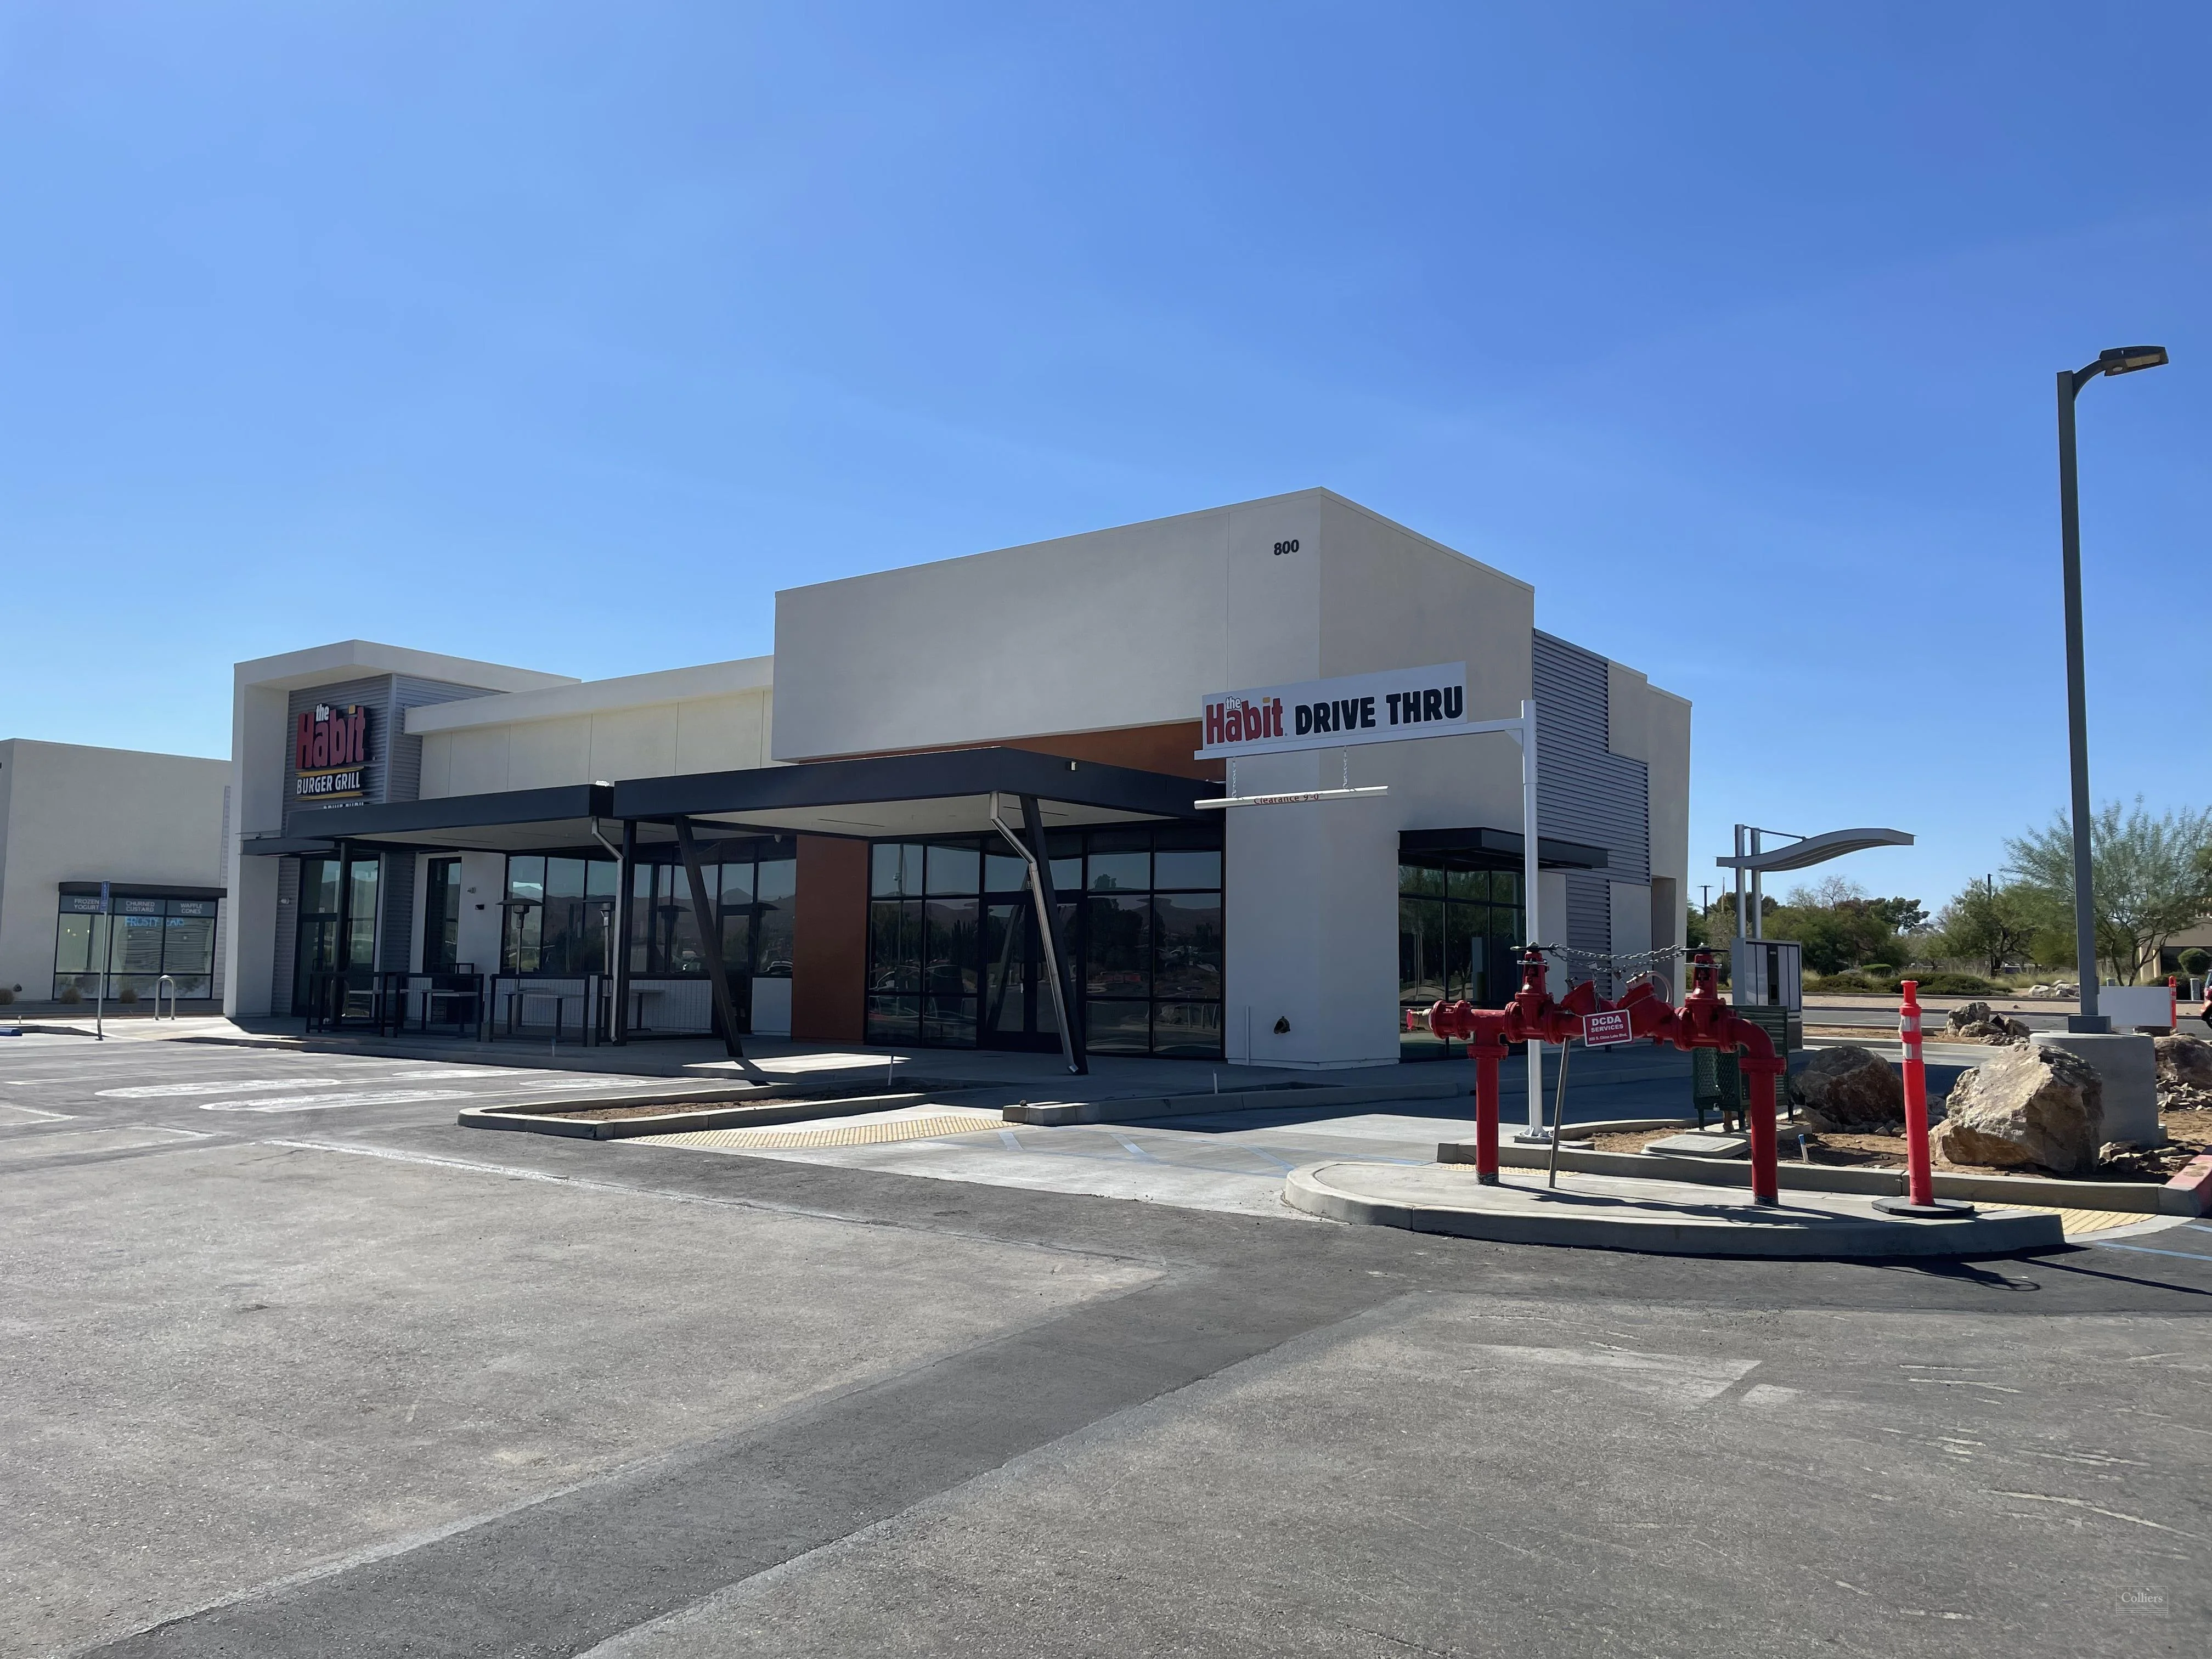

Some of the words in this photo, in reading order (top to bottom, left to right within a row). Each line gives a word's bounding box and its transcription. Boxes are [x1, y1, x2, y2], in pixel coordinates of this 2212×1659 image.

[1274, 539, 1299, 555] 800
[1226, 696, 1241, 710] the
[316, 704, 329, 721] the
[1206, 697, 1283, 744] Habit
[1295, 697, 1375, 735] DRIVE
[1386, 686, 1463, 725] THRU
[296, 705, 366, 769] Habit
[297, 775, 333, 794] BURGER
[335, 772, 360, 790] GRILL
[1254, 795, 1300, 804] Clearance
[125, 916, 159, 927] FROSTY
[1591, 1024, 1624, 1032] SERVICES
[1592, 1015, 1622, 1026] DCDA
